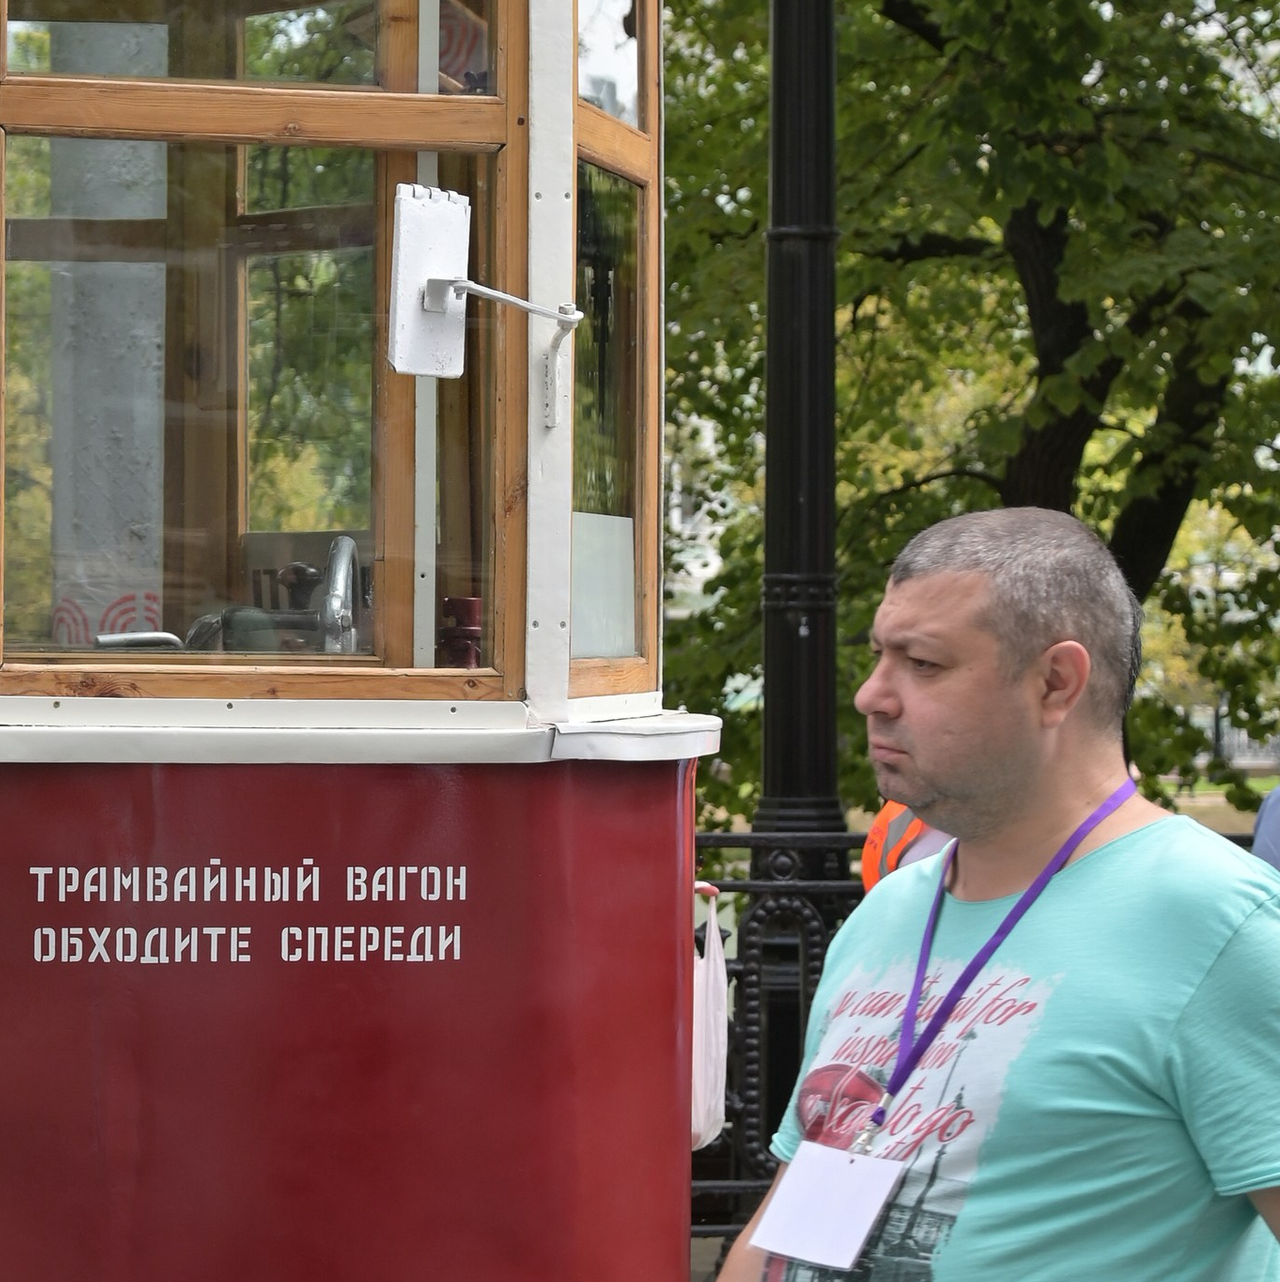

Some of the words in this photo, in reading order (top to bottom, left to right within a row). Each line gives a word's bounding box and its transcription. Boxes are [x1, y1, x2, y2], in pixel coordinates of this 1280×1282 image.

[28, 857, 321, 903] ТРАМВАЙНЫЙ
[345, 866, 468, 902] ВАГОН
[32, 926, 253, 964] ОБХОДИТЕ
[280, 925, 462, 963] СПЕРЕДИ
